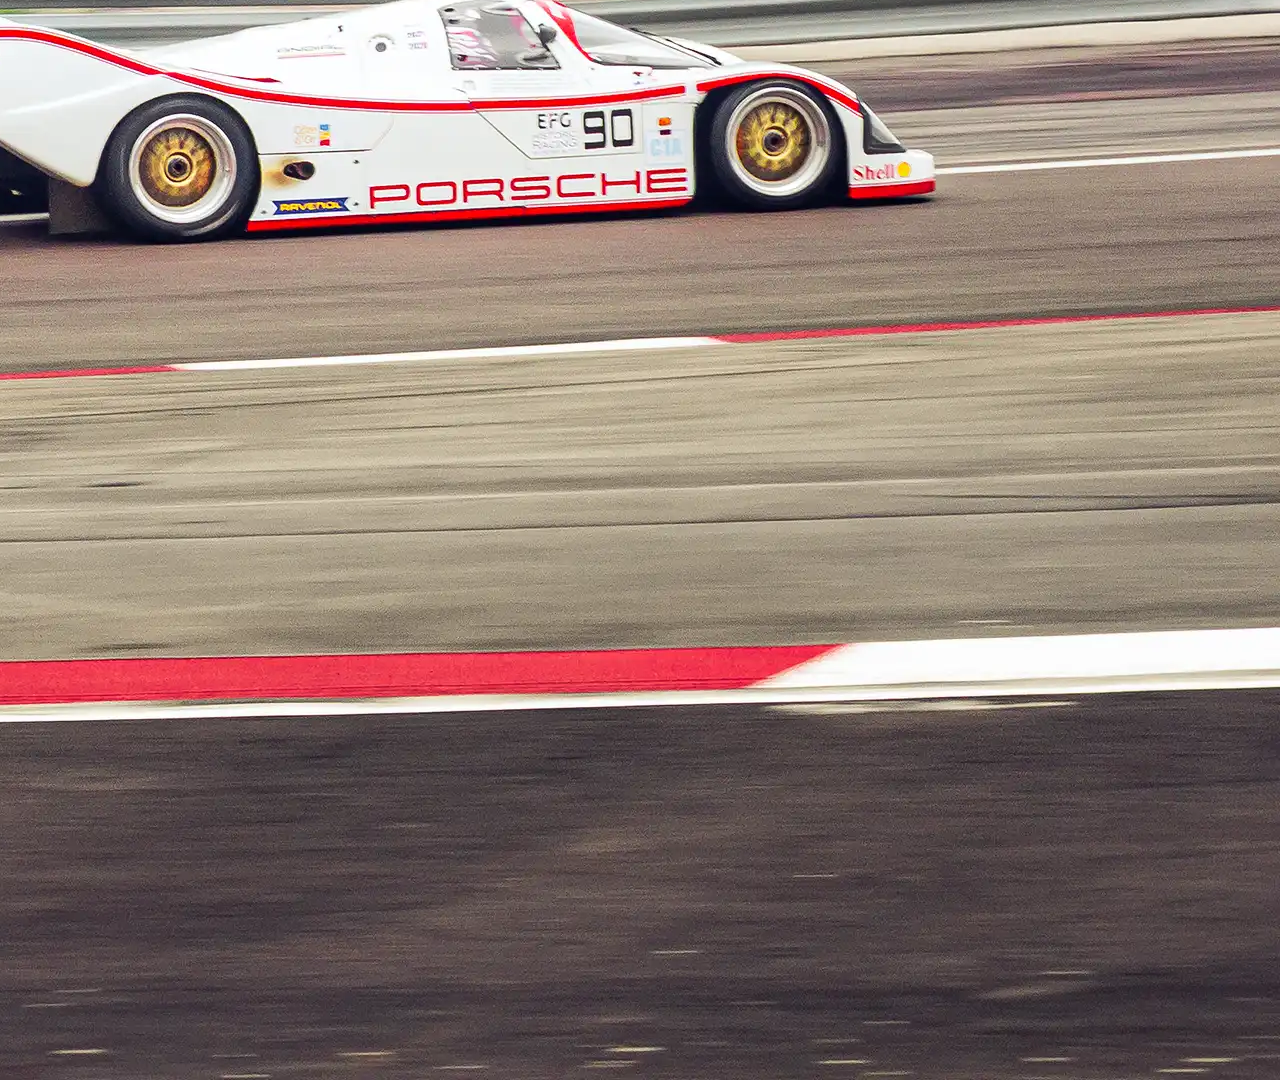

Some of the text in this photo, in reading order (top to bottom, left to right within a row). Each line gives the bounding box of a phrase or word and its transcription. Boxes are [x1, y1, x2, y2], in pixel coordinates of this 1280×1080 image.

[537, 112, 572, 129] EFG
[583, 108, 634, 150] 90
[650, 138, 683, 157] C1A
[852, 164, 895, 181] Shell
[369, 168, 688, 209] PORSCHE
[279, 200, 342, 212] RAVENOL
